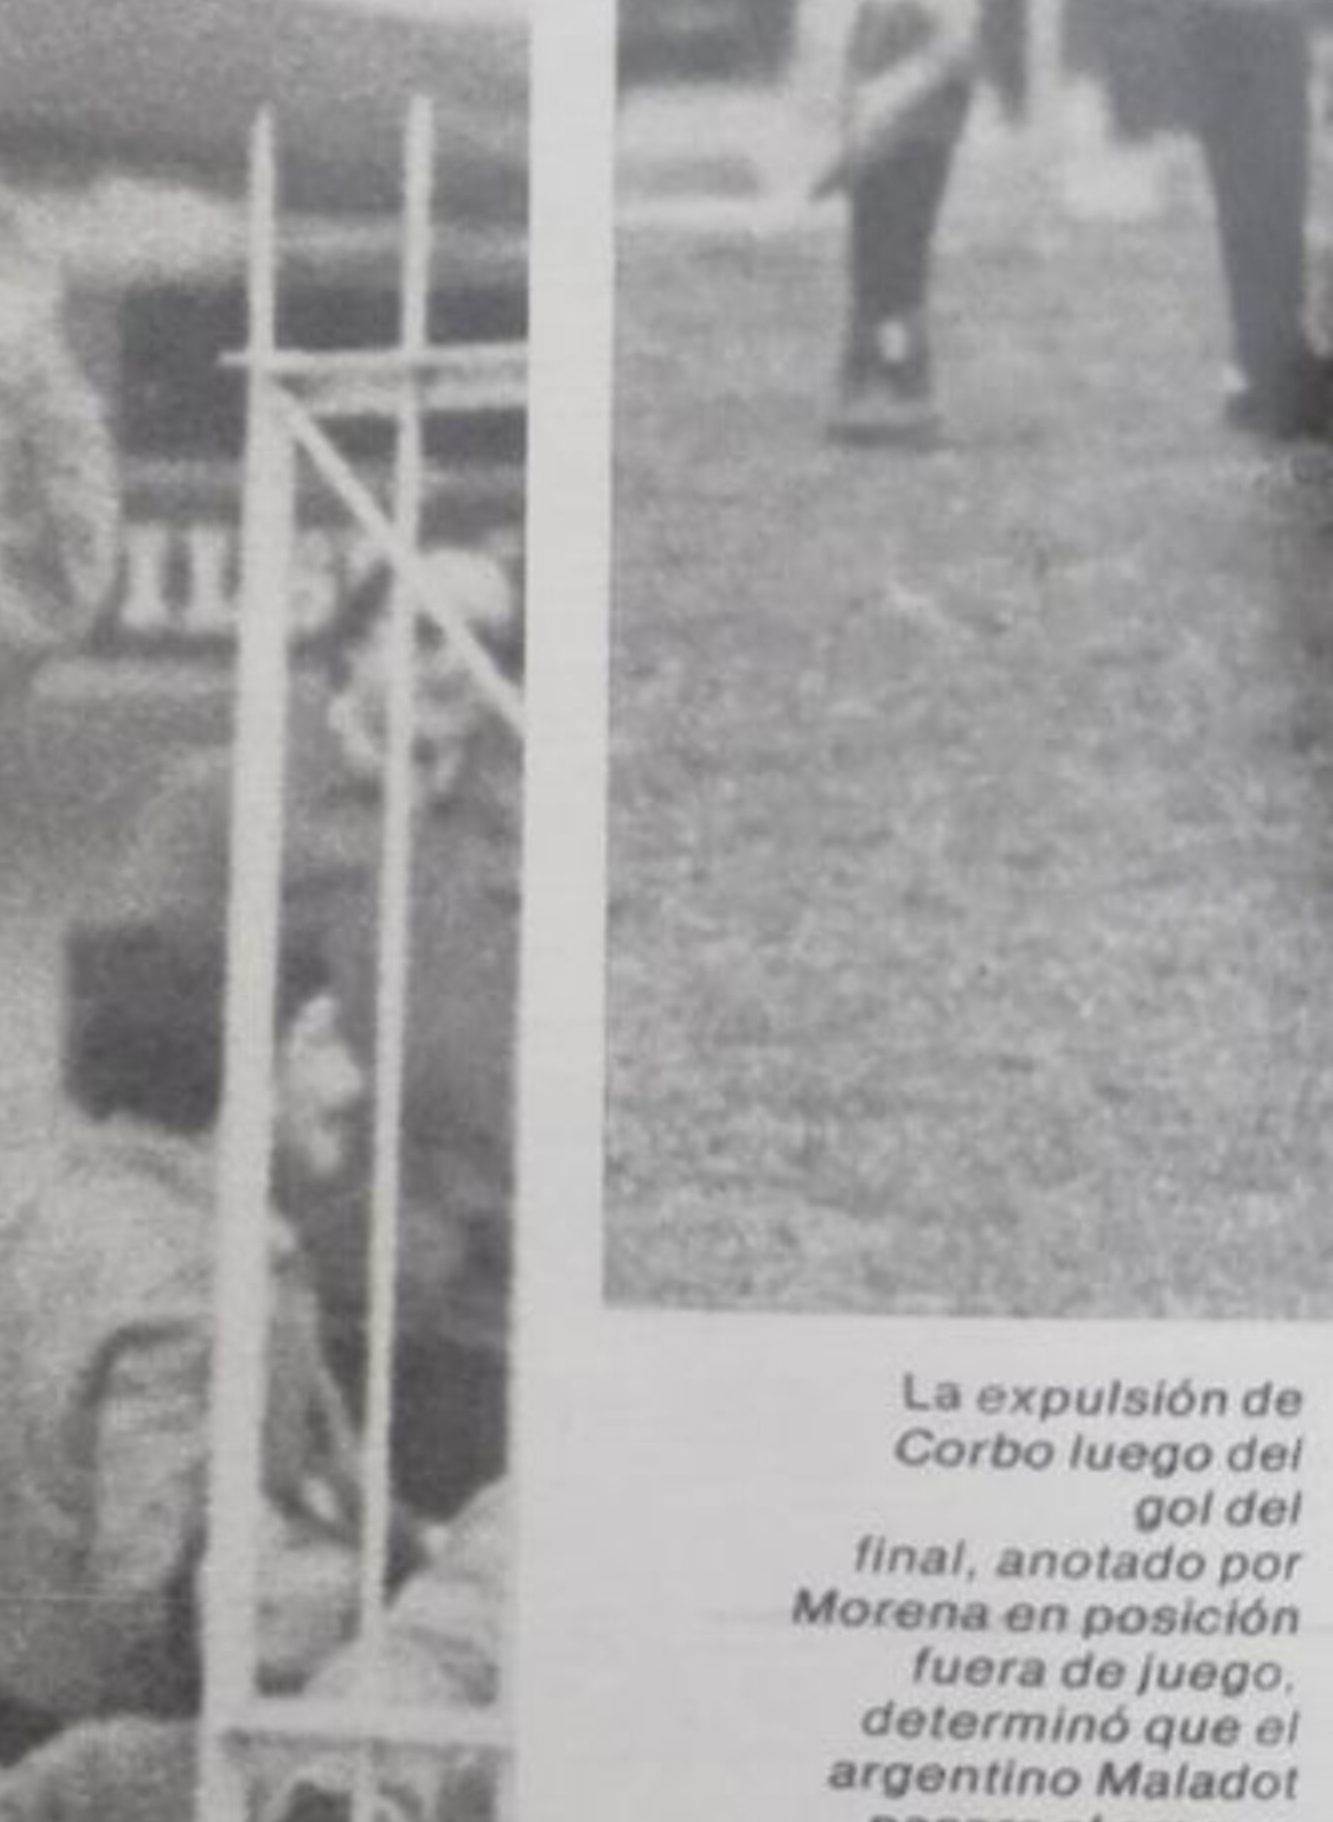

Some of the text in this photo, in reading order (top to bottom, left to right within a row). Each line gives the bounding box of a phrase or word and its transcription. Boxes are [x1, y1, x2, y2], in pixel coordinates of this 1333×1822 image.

[903, 1373, 1303, 1422] La expulsión de
[894, 1428, 1303, 1479] Corbo luego del
[1135, 1491, 1302, 1533] gol del
[856, 1535, 1302, 1587] final, anotado por
[791, 1587, 1299, 1639] Morena en posición
[913, 1647, 1045, 1687] fuera
[1061, 1653, 1125, 1689] de
[861, 1700, 1301, 1750] determinó que el
[827, 1760, 1298, 1800] argentino Maladot
